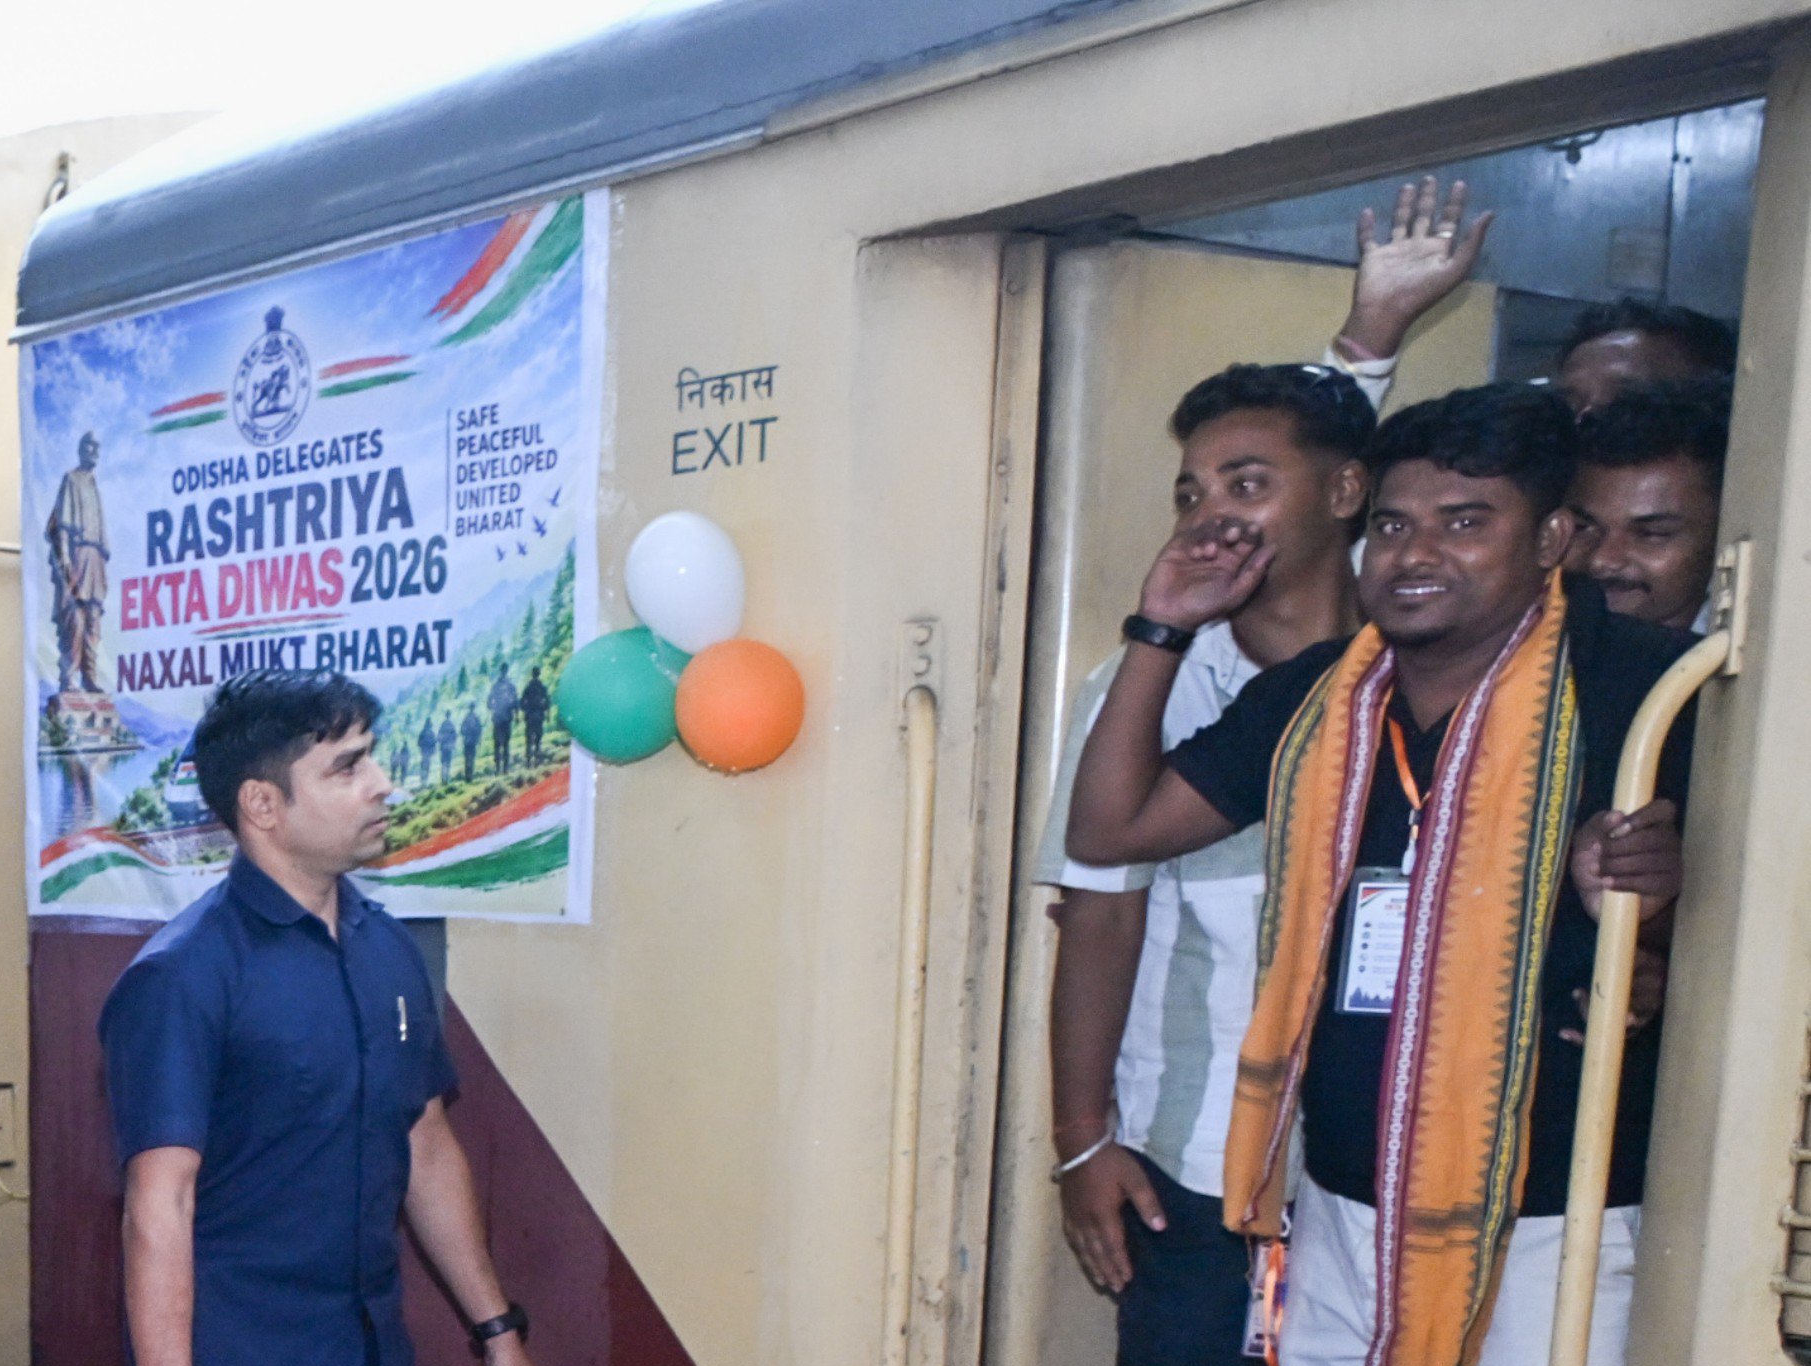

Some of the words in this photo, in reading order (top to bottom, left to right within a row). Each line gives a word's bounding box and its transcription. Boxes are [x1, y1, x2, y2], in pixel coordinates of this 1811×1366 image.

[675, 365, 778, 413] निकास
[456, 403, 499, 431] SAFE
[456, 423, 544, 458] PEACEFUL
[172, 455, 249, 495] ODISHA
[256, 428, 383, 480] DELEGATES
[456, 448, 558, 485] DEVELOPED
[672, 416, 778, 476] EXIT
[146, 466, 414, 568] RASHTRIYA
[456, 482, 521, 511] UNITED
[455, 507, 524, 537] BHARAT
[120, 568, 210, 632] EKTA
[218, 547, 345, 620] DIWAS
[350, 534, 448, 604] 2026
[116, 645, 214, 692] NAXAL
[220, 635, 307, 680] MUKT
[315, 619, 453, 674] BHARAT
